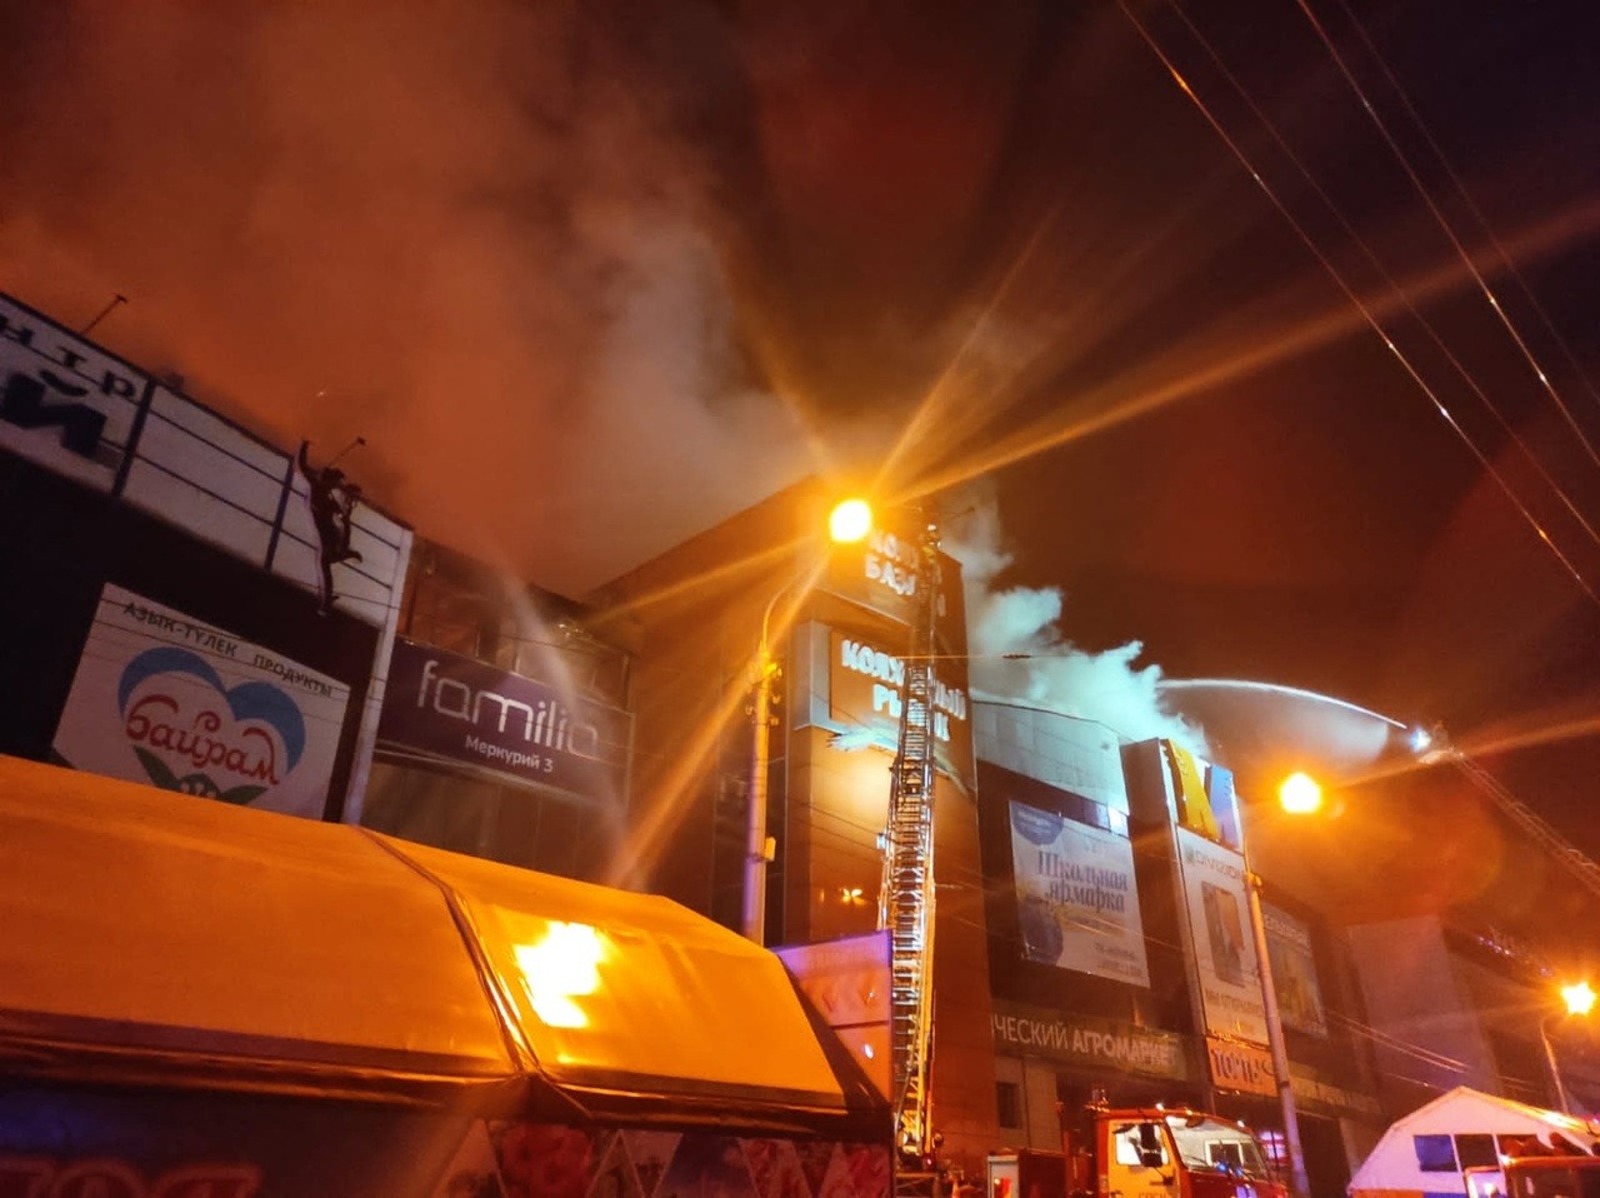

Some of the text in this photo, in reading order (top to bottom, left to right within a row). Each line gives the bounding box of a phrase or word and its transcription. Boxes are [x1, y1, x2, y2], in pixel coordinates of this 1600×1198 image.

[253, 653, 333, 697] ПРОДУКТЫ
[417, 659, 599, 762] familia
[465, 734, 554, 774] Меркурий 3
[1045, 879, 1126, 914] ярмарка
[991, 1012, 1068, 1050] ЧЕСКИЙ
